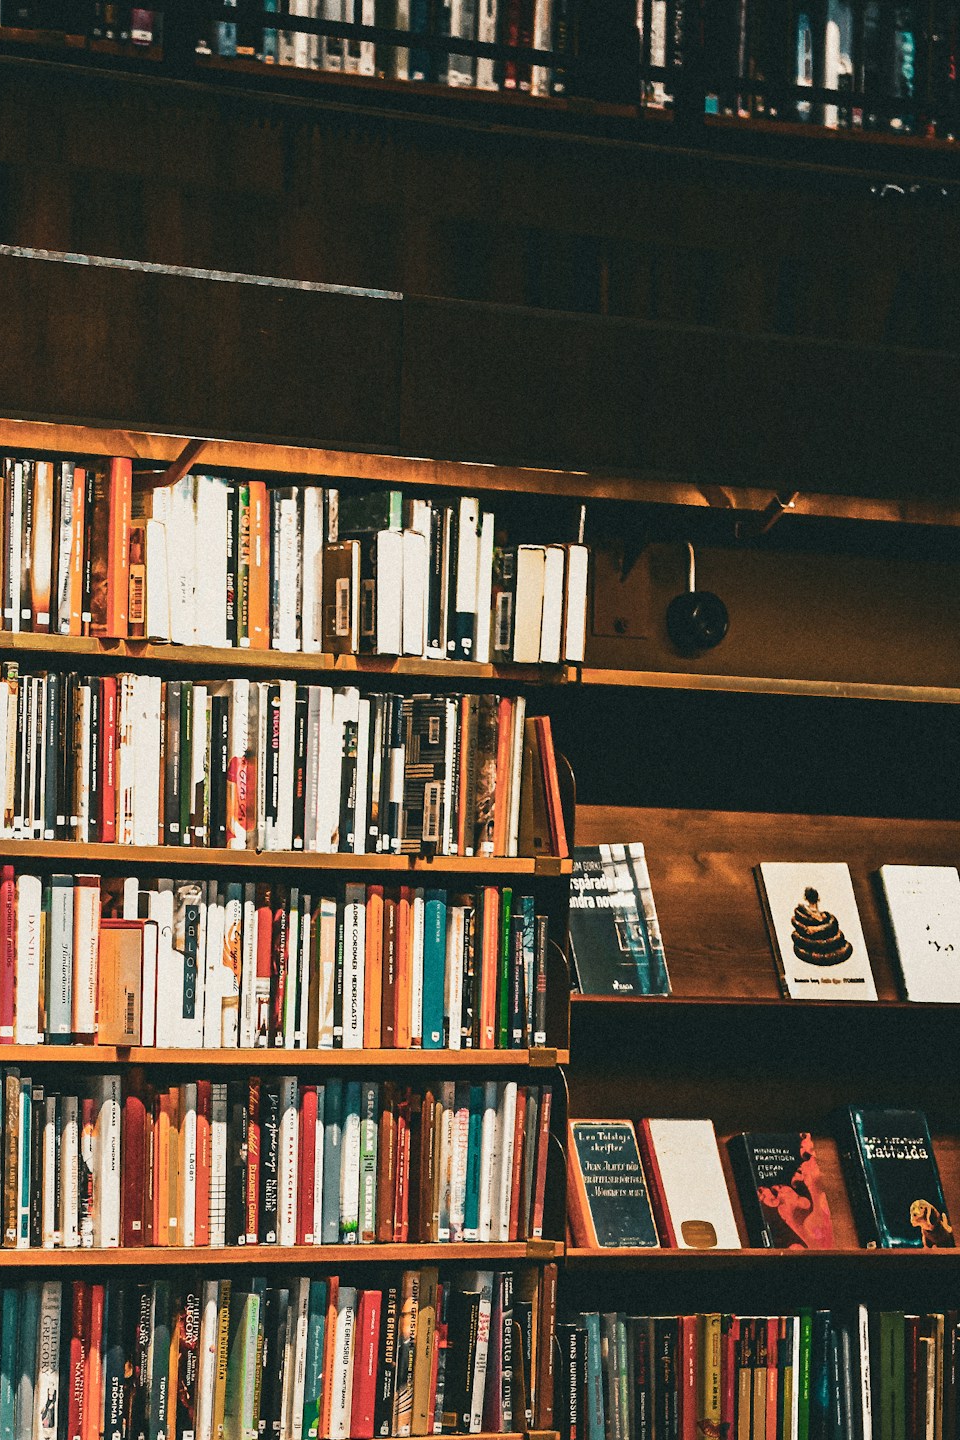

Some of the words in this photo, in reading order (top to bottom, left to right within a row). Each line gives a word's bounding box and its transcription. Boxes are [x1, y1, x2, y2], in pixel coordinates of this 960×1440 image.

[366, 1090, 374, 1151] GRAHAM
[597, 1132, 630, 1144] Tolstojs
[591, 1143, 623, 1154] skrifter
[248, 1164, 257, 1201] ELIZABETH
[364, 1175, 373, 1229] GREENE
[185, 1294, 193, 1345] GREGORY
[344, 1306, 352, 1327] BEATE
[387, 1288, 396, 1314] BEATE
[42, 1315, 50, 1376] GREGORY
[343, 1328, 351, 1365] GRIMSRUD
[385, 1318, 395, 1363] GRIMSRUD
[111, 1377, 119, 1424] STRÖMMAR
[502, 1386, 510, 1407] mig
